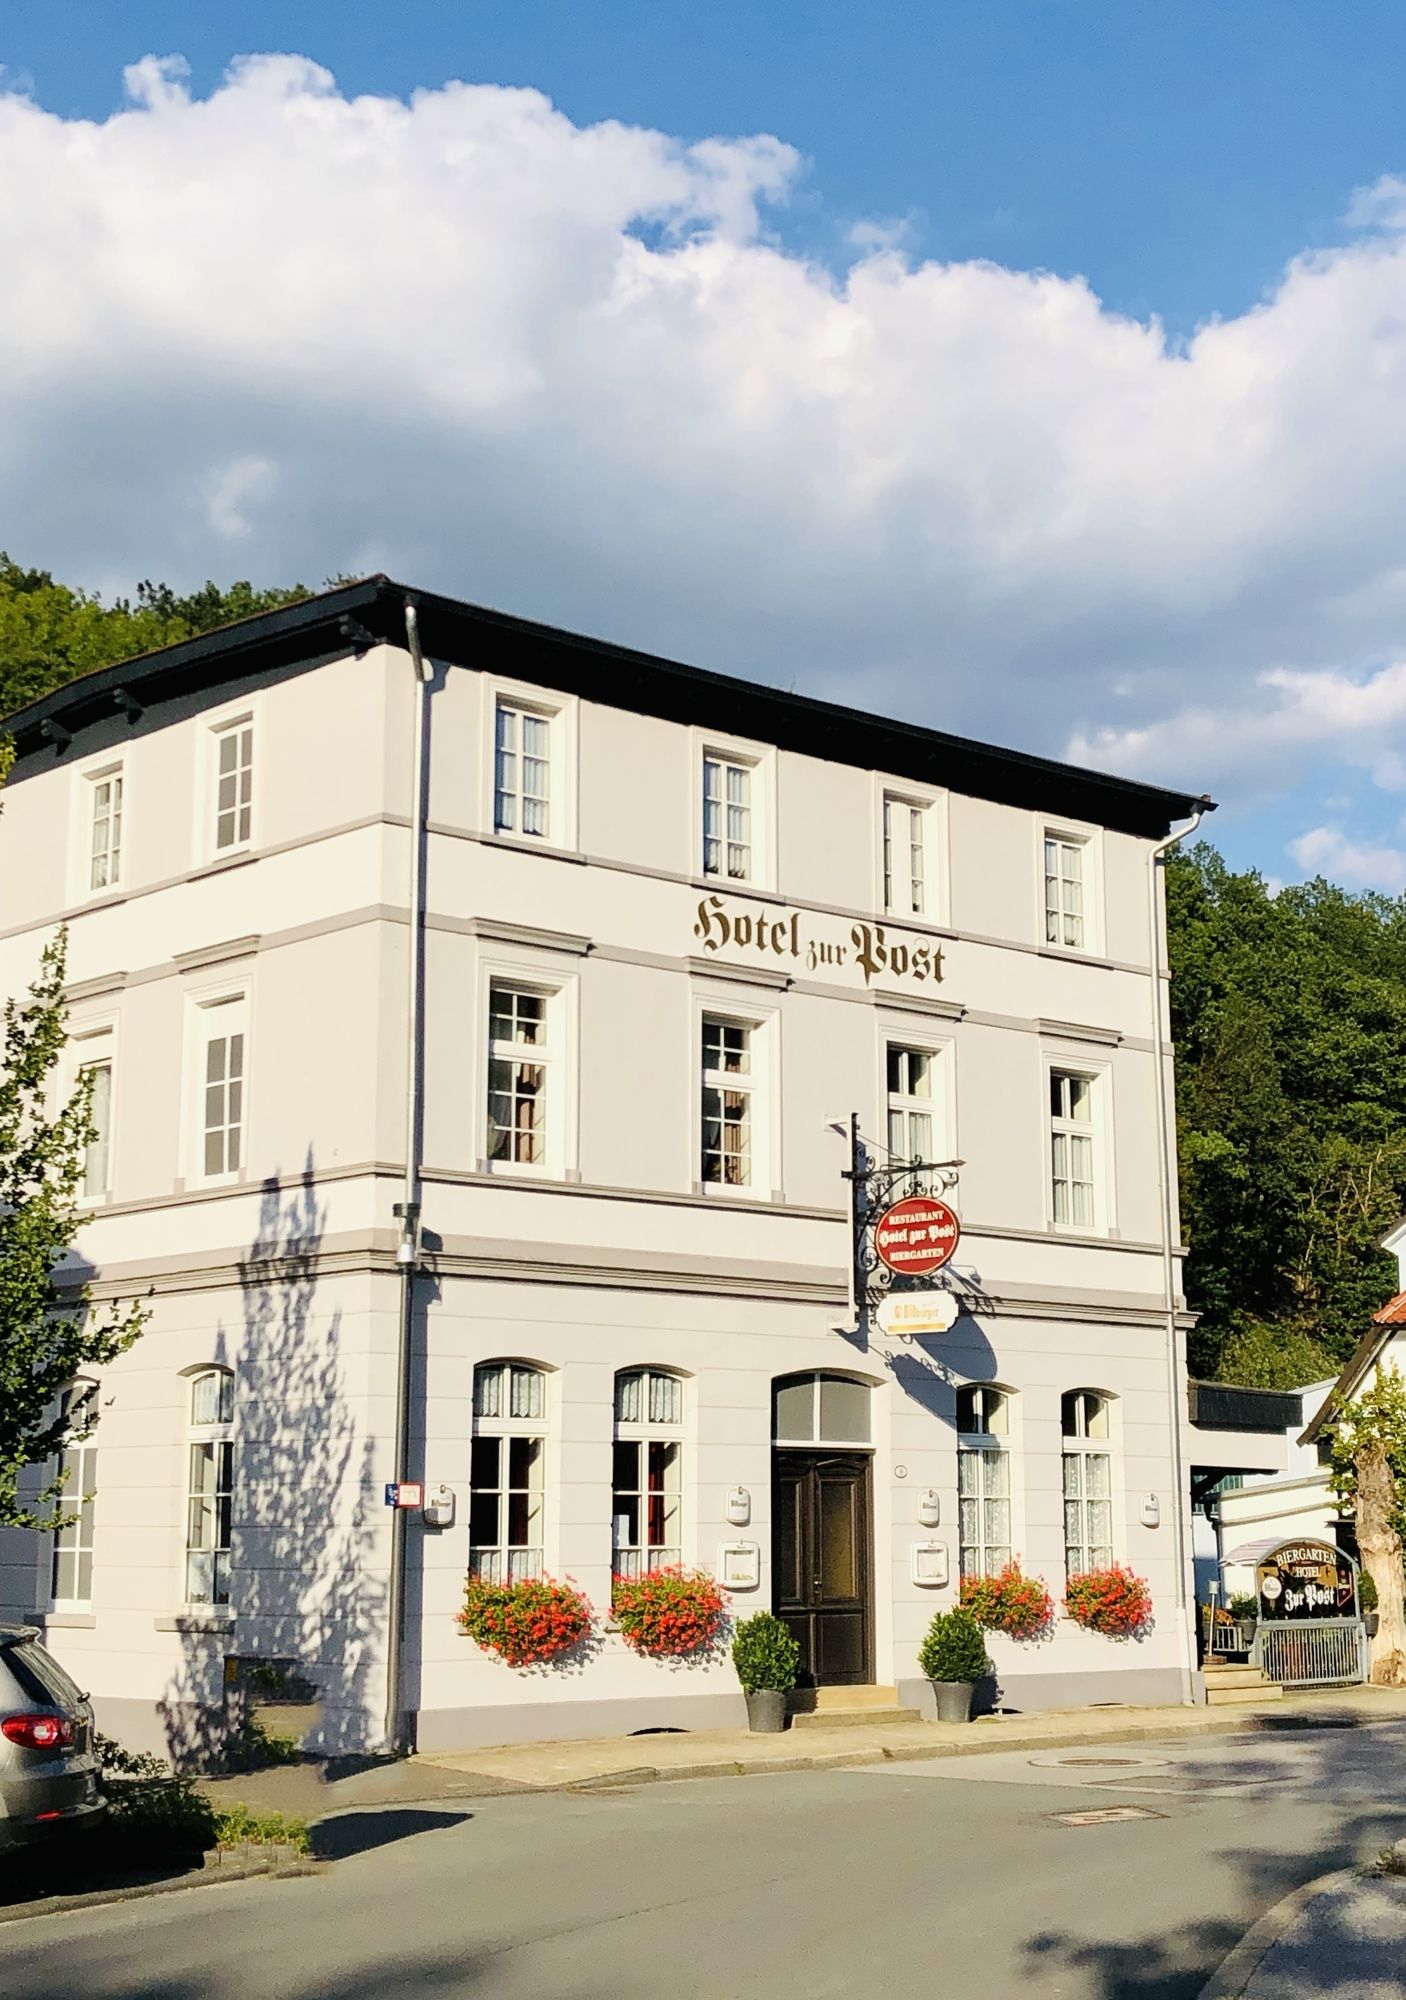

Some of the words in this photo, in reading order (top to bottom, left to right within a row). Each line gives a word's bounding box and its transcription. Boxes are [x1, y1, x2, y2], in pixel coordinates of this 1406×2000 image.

[693, 895, 801, 958] Hotel
[806, 938, 848, 971] zur
[851, 923, 946, 986] Post
[889, 1210, 944, 1225] RESTAURANT
[879, 1229, 908, 1248] Hotel
[909, 1229, 927, 1245] zur
[928, 1224, 955, 1242] Post
[890, 1248, 944, 1262] BIERGARTEN
[1276, 1548, 1337, 1567] BIERGARTEN
[1295, 1566, 1321, 1578] HOTEL
[1304, 1584, 1335, 1612] Post
